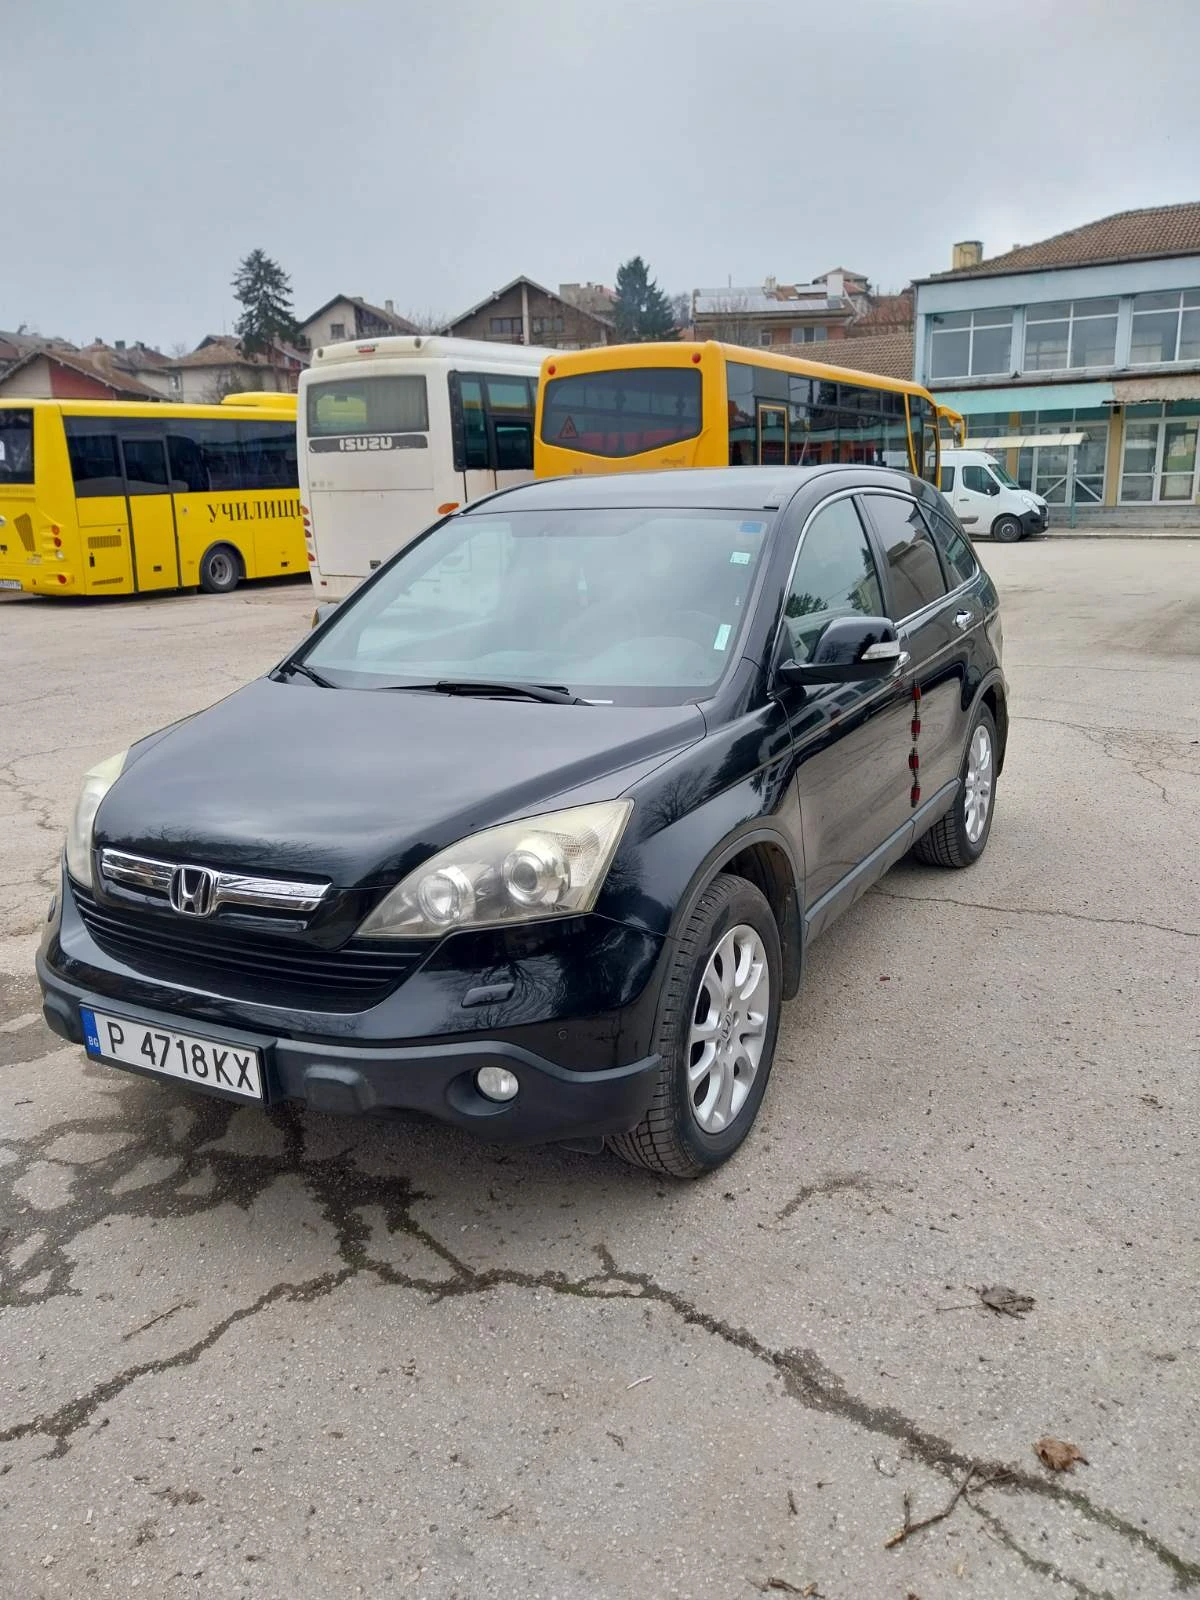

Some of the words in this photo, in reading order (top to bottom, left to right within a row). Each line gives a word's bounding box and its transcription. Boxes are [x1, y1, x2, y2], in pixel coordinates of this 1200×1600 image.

[339, 436, 393, 452] ISUZU
[87, 1035, 100, 1048] BG
[107, 1021, 125, 1054] P
